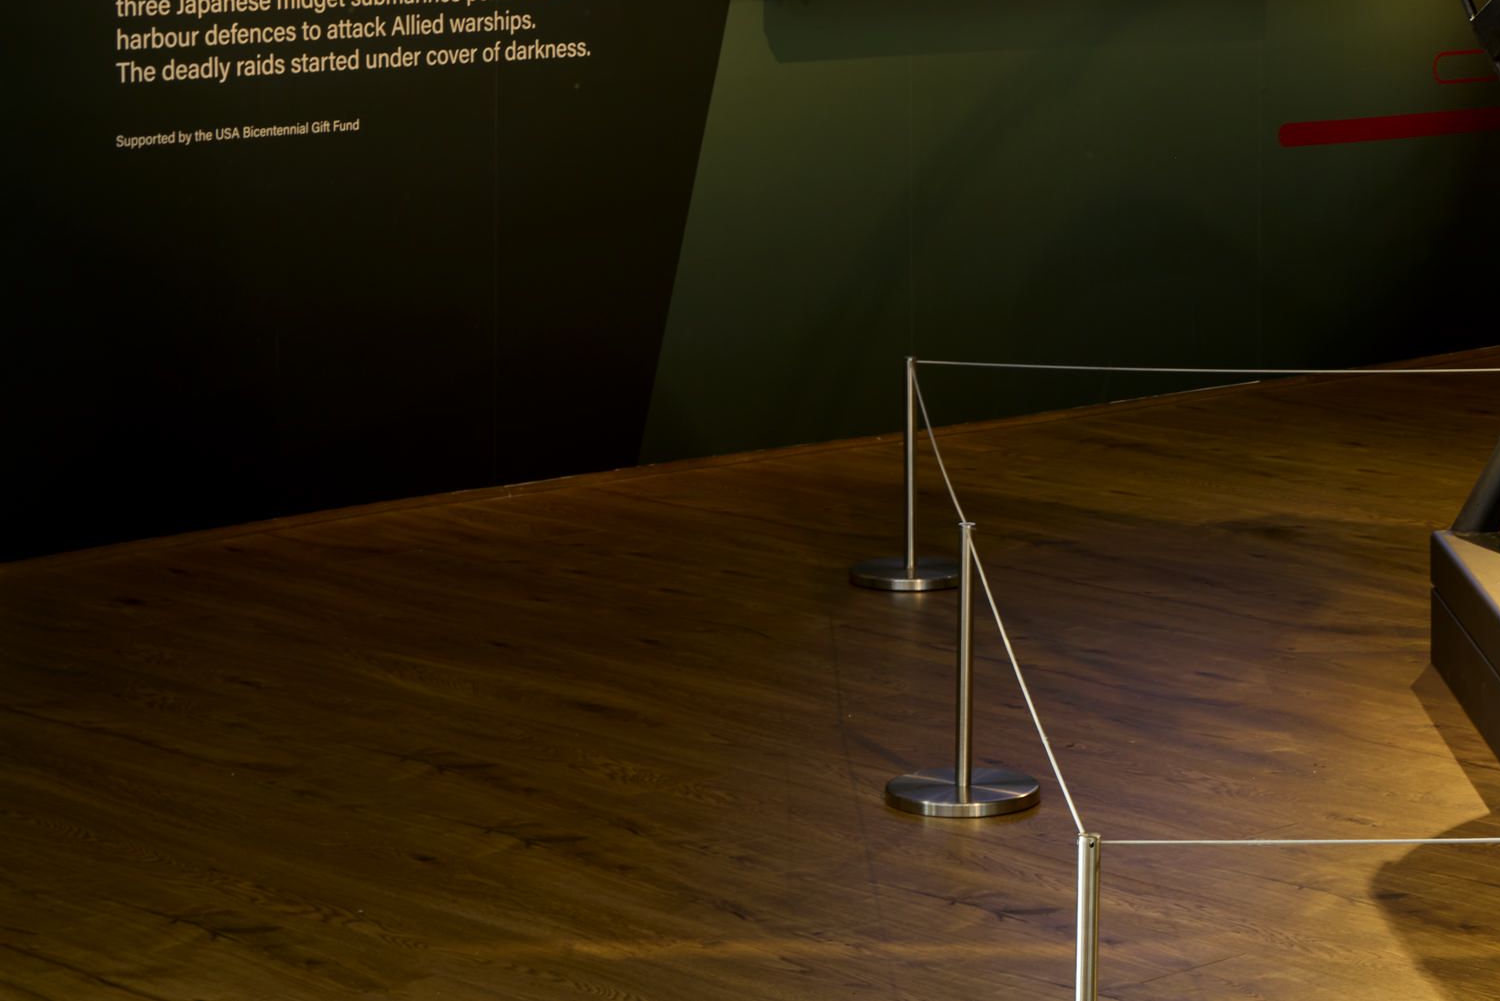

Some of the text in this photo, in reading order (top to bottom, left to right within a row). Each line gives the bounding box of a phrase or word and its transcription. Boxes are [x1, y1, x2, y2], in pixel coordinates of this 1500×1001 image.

[117, 10, 535, 50] harbour defences to attack Allied warships.
[116, 39, 590, 83] The deadly raids started under cover of darkness.
[116, 119, 359, 148] Supported by the USA Bicentennial Gift Fund
